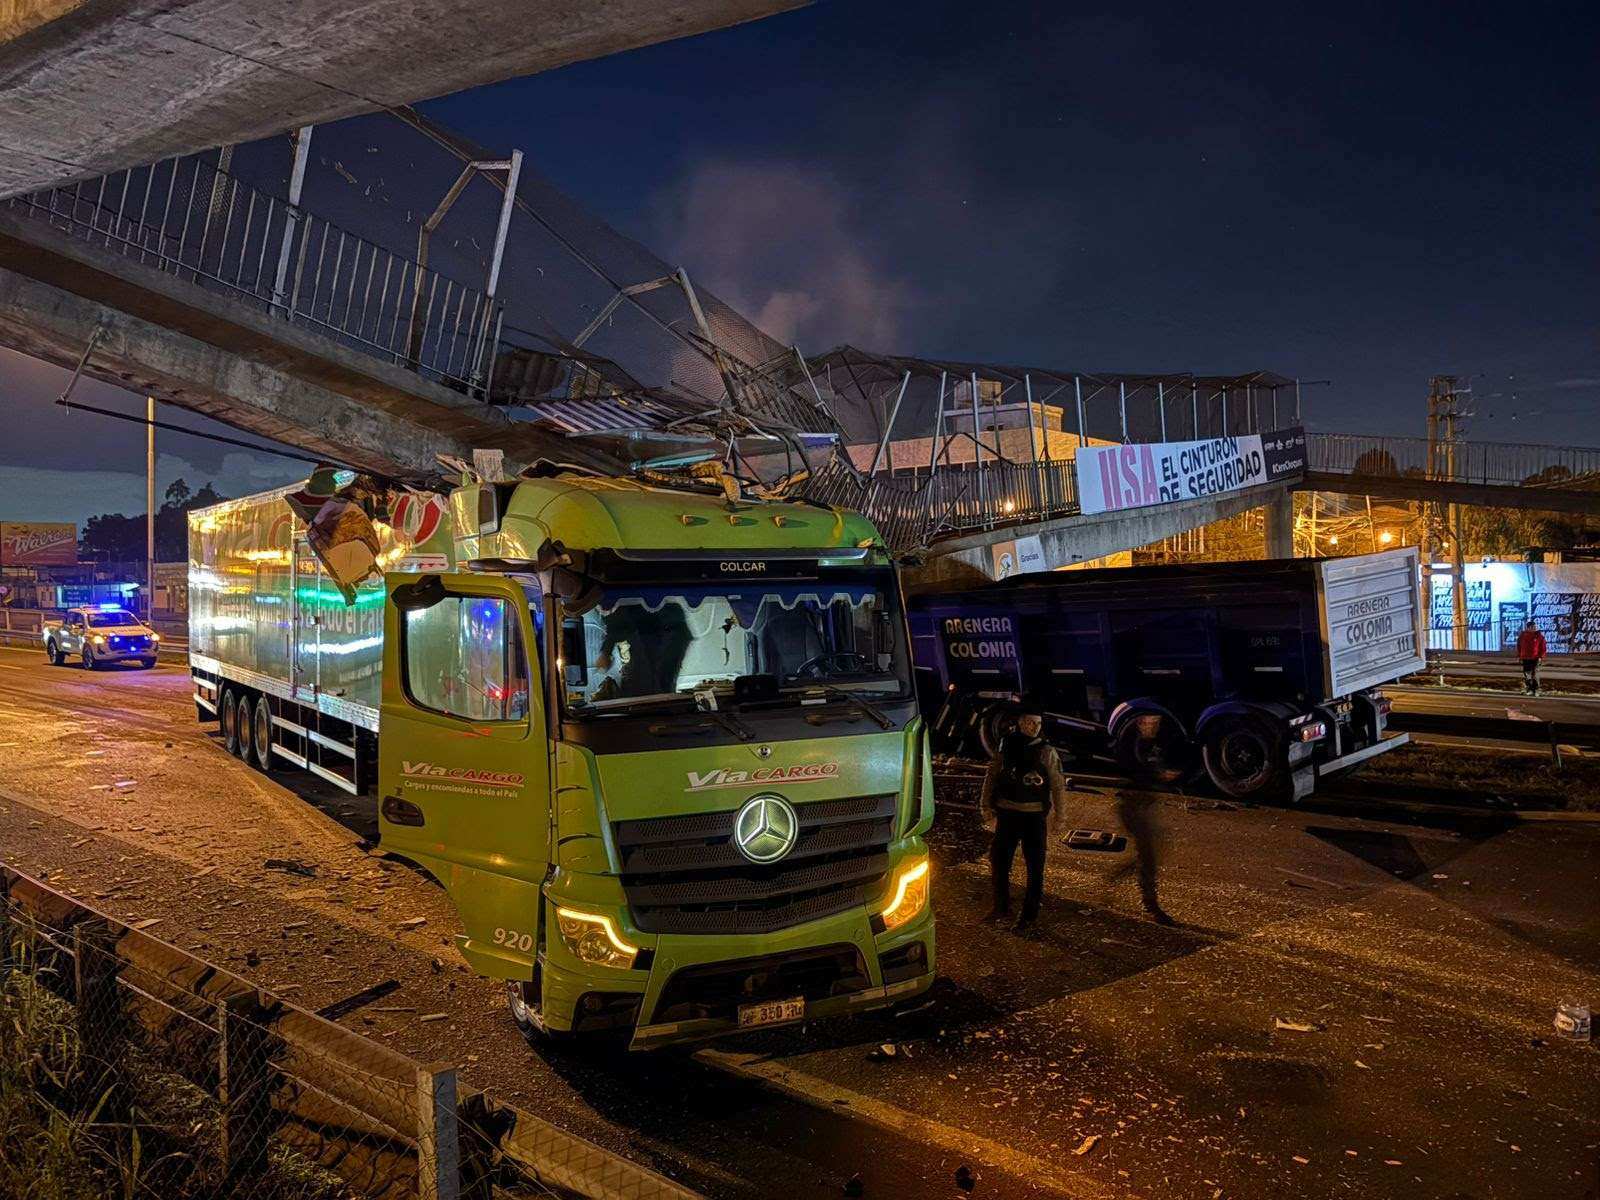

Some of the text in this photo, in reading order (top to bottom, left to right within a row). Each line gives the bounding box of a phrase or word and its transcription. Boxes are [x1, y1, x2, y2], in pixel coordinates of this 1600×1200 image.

[1159, 450, 1261, 502] DE SEGURIDAD
[1161, 456, 1178, 482] EL
[720, 562, 766, 572] COLCAR
[1347, 596, 1390, 617] ARENERA
[945, 617, 1012, 633] ARENERA
[1346, 615, 1393, 644] COLONIA
[949, 641, 1017, 658] COLONIA
[492, 927, 533, 951] 920
